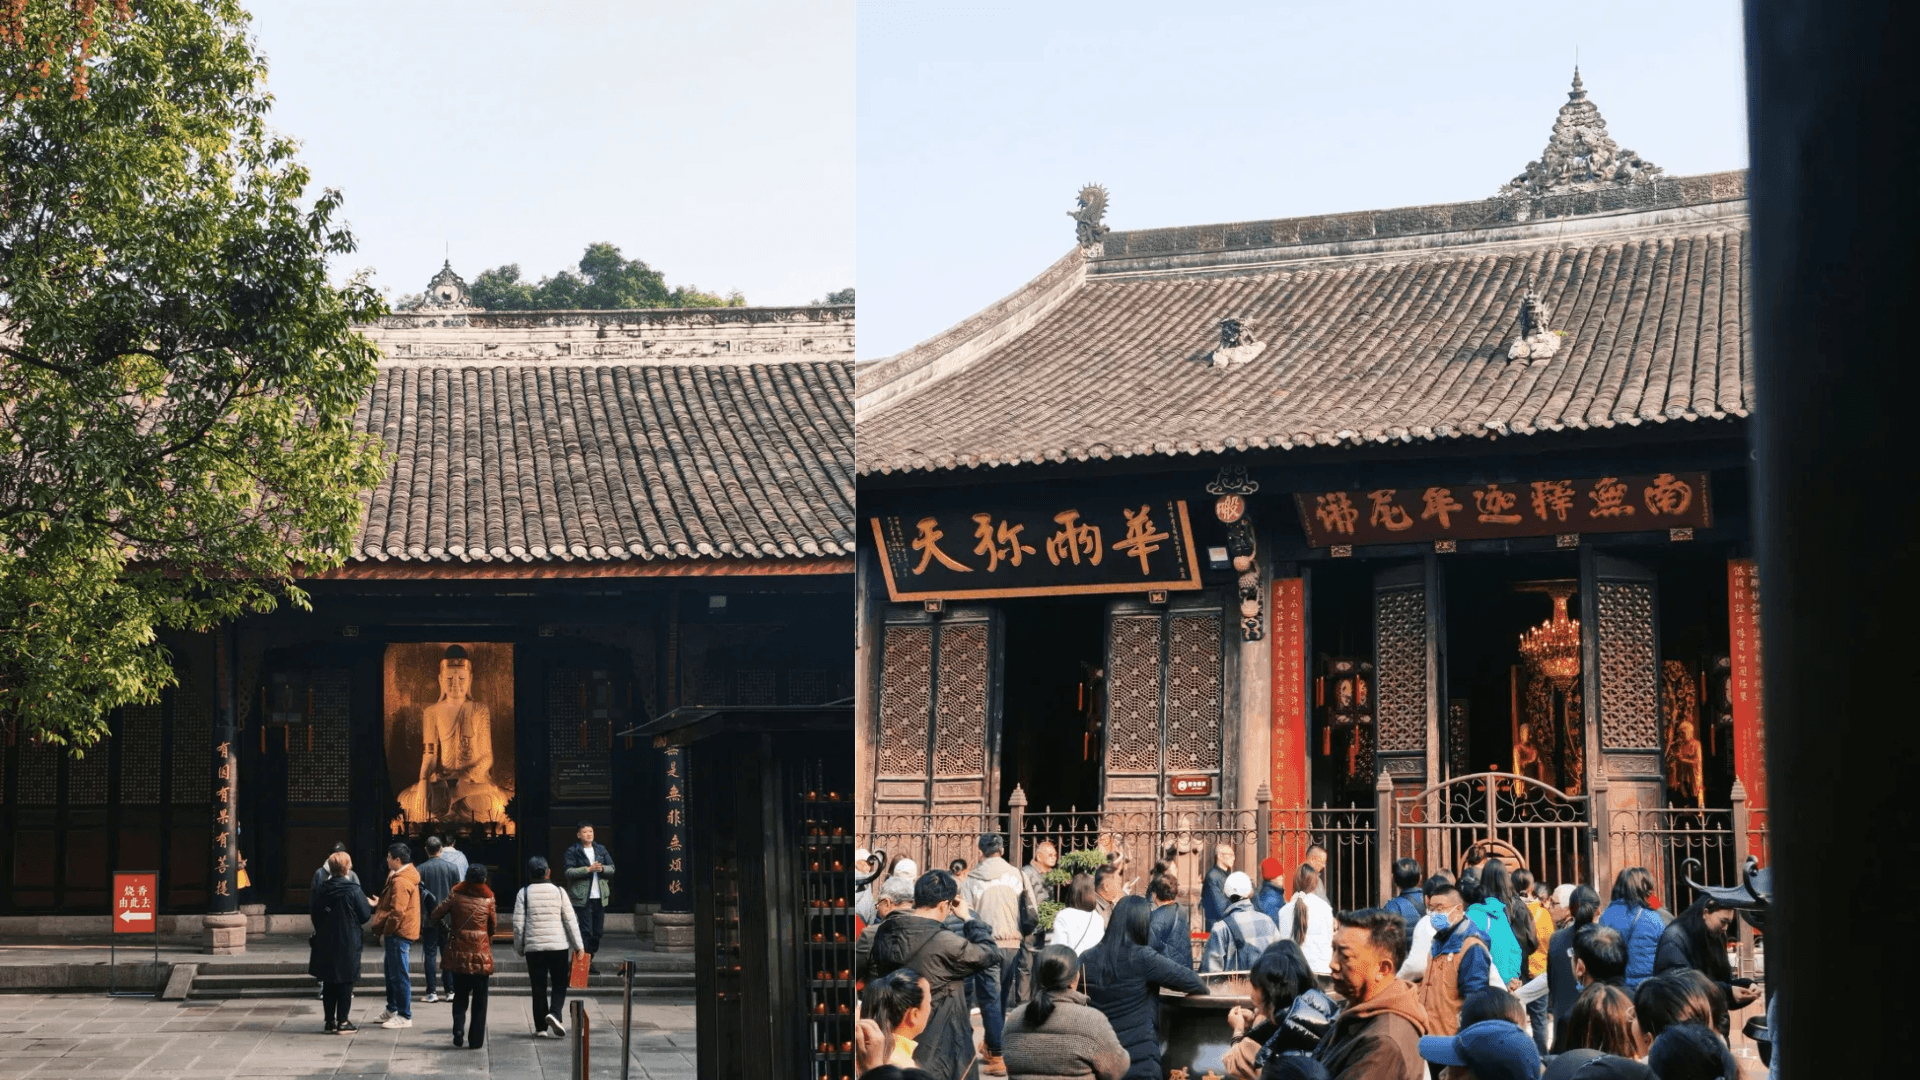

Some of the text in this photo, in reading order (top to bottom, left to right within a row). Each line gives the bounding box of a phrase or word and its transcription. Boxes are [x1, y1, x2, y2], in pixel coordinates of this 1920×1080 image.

[1316, 473, 1693, 535] 南無釋迦牟尼佛
[214, 741, 231, 897] 有因有果有菩提
[119, 896, 151, 908] 由此去
[124, 885, 148, 896] 烧香
